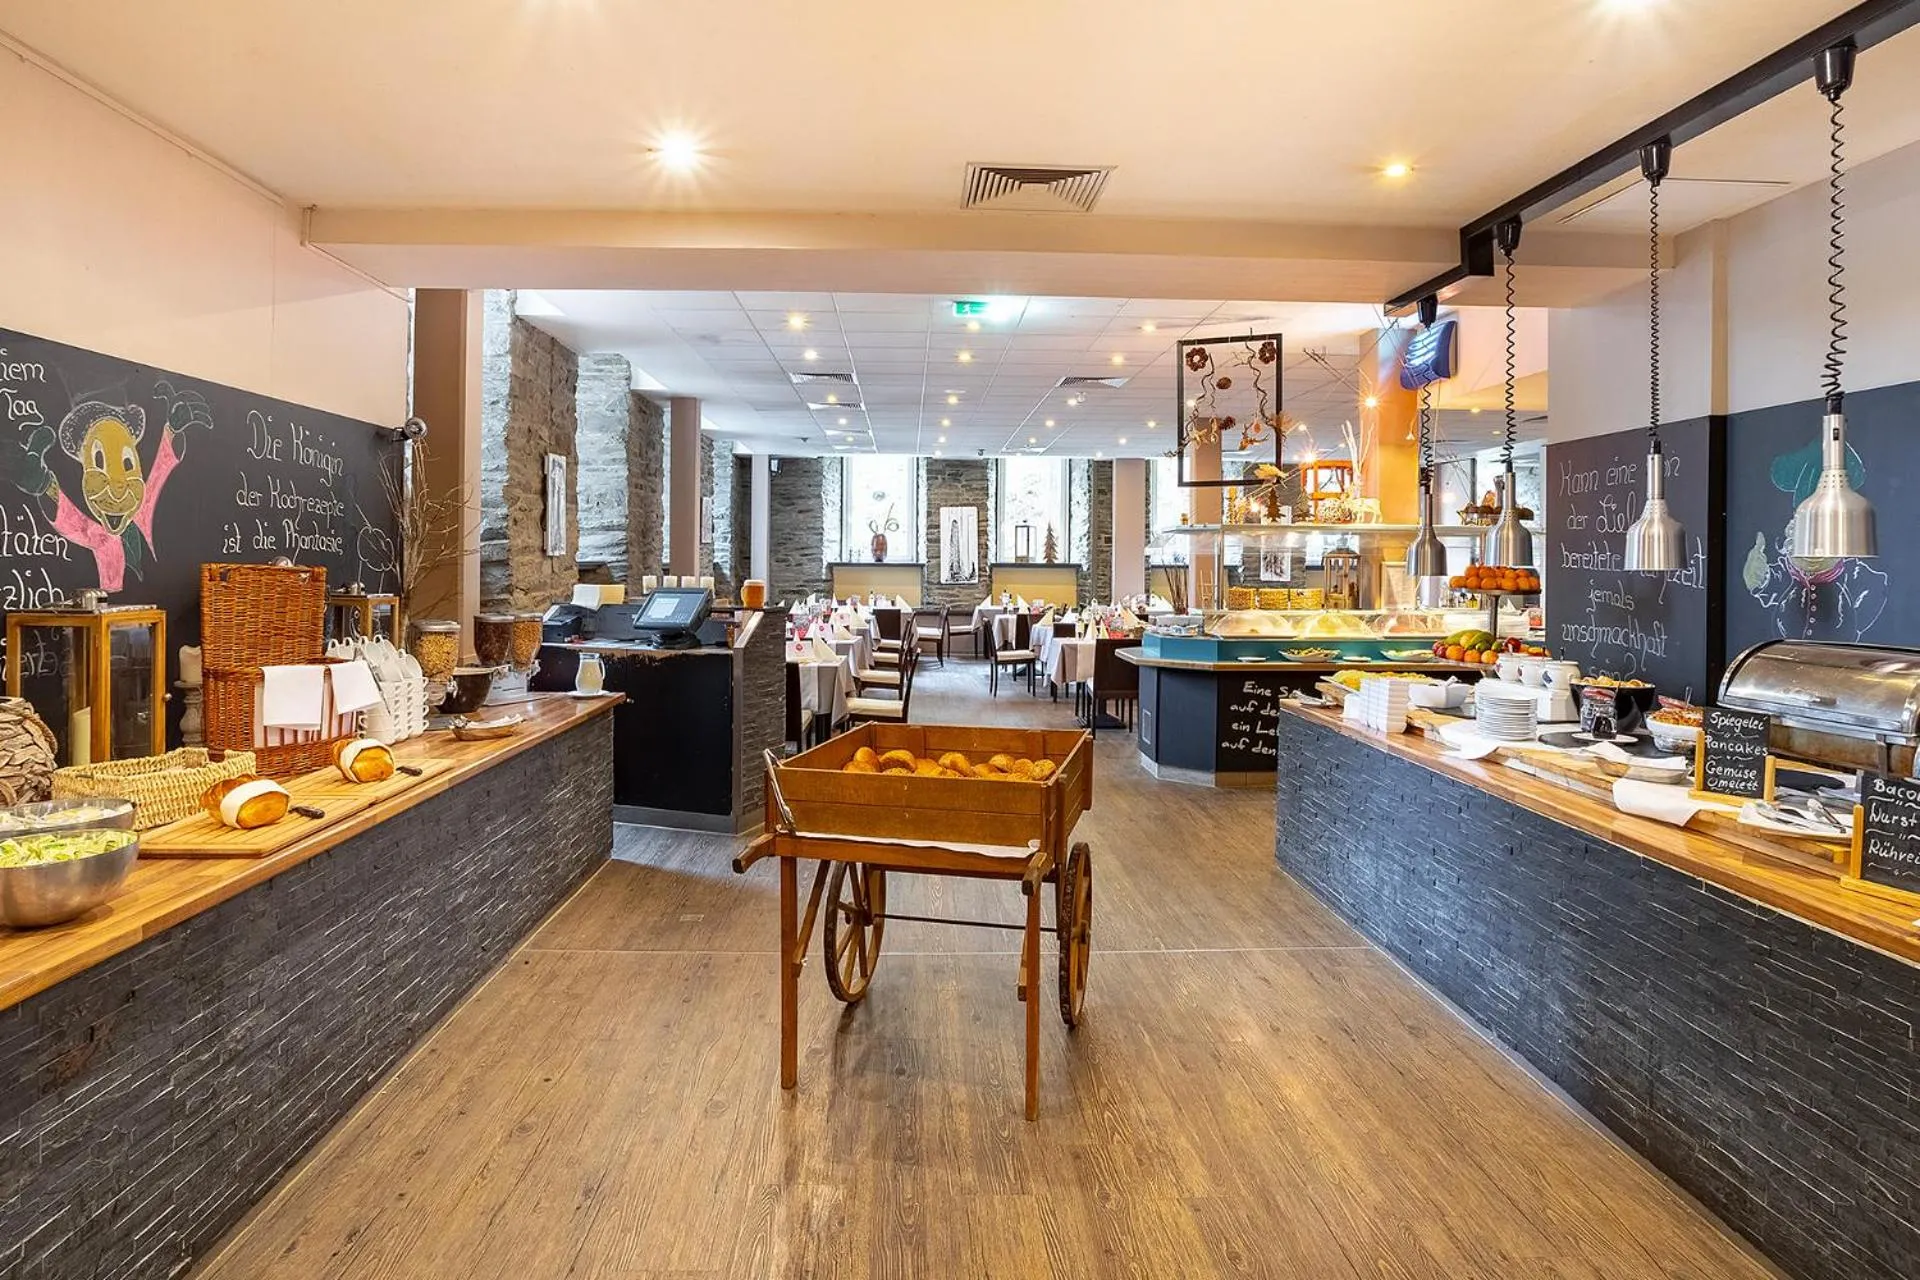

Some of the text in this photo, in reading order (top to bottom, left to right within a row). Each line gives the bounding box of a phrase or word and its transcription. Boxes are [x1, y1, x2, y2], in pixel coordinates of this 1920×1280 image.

[0, 388, 45, 431] Tag
[246, 410, 283, 462] Die
[1559, 460, 1599, 497] Kann
[1606, 457, 1638, 486] eine
[236, 470, 345, 530] der Kochrezepte
[1567, 504, 1588, 531] der
[0, 504, 72, 562] täten
[223, 522, 241, 554] ist
[253, 518, 276, 550] die
[1560, 540, 1625, 572] bereitete
[0, 567, 65, 610] zlich
[1586, 579, 1636, 614] jemals
[1562, 613, 1668, 672] unschmackhaft
[1243, 681, 1272, 697] Eine
[1230, 701, 1280, 717] auf de
[1709, 711, 1768, 733] Spiegelei
[1232, 721, 1250, 732] ein
[1221, 737, 1250, 751] auf
[1705, 734, 1769, 756] Pancakes
[1705, 760, 1757, 780] Gemüse
[1707, 777, 1759, 791] Omelett
[1874, 779, 1920, 802] Baco
[1869, 802, 1918, 828] Wurst
